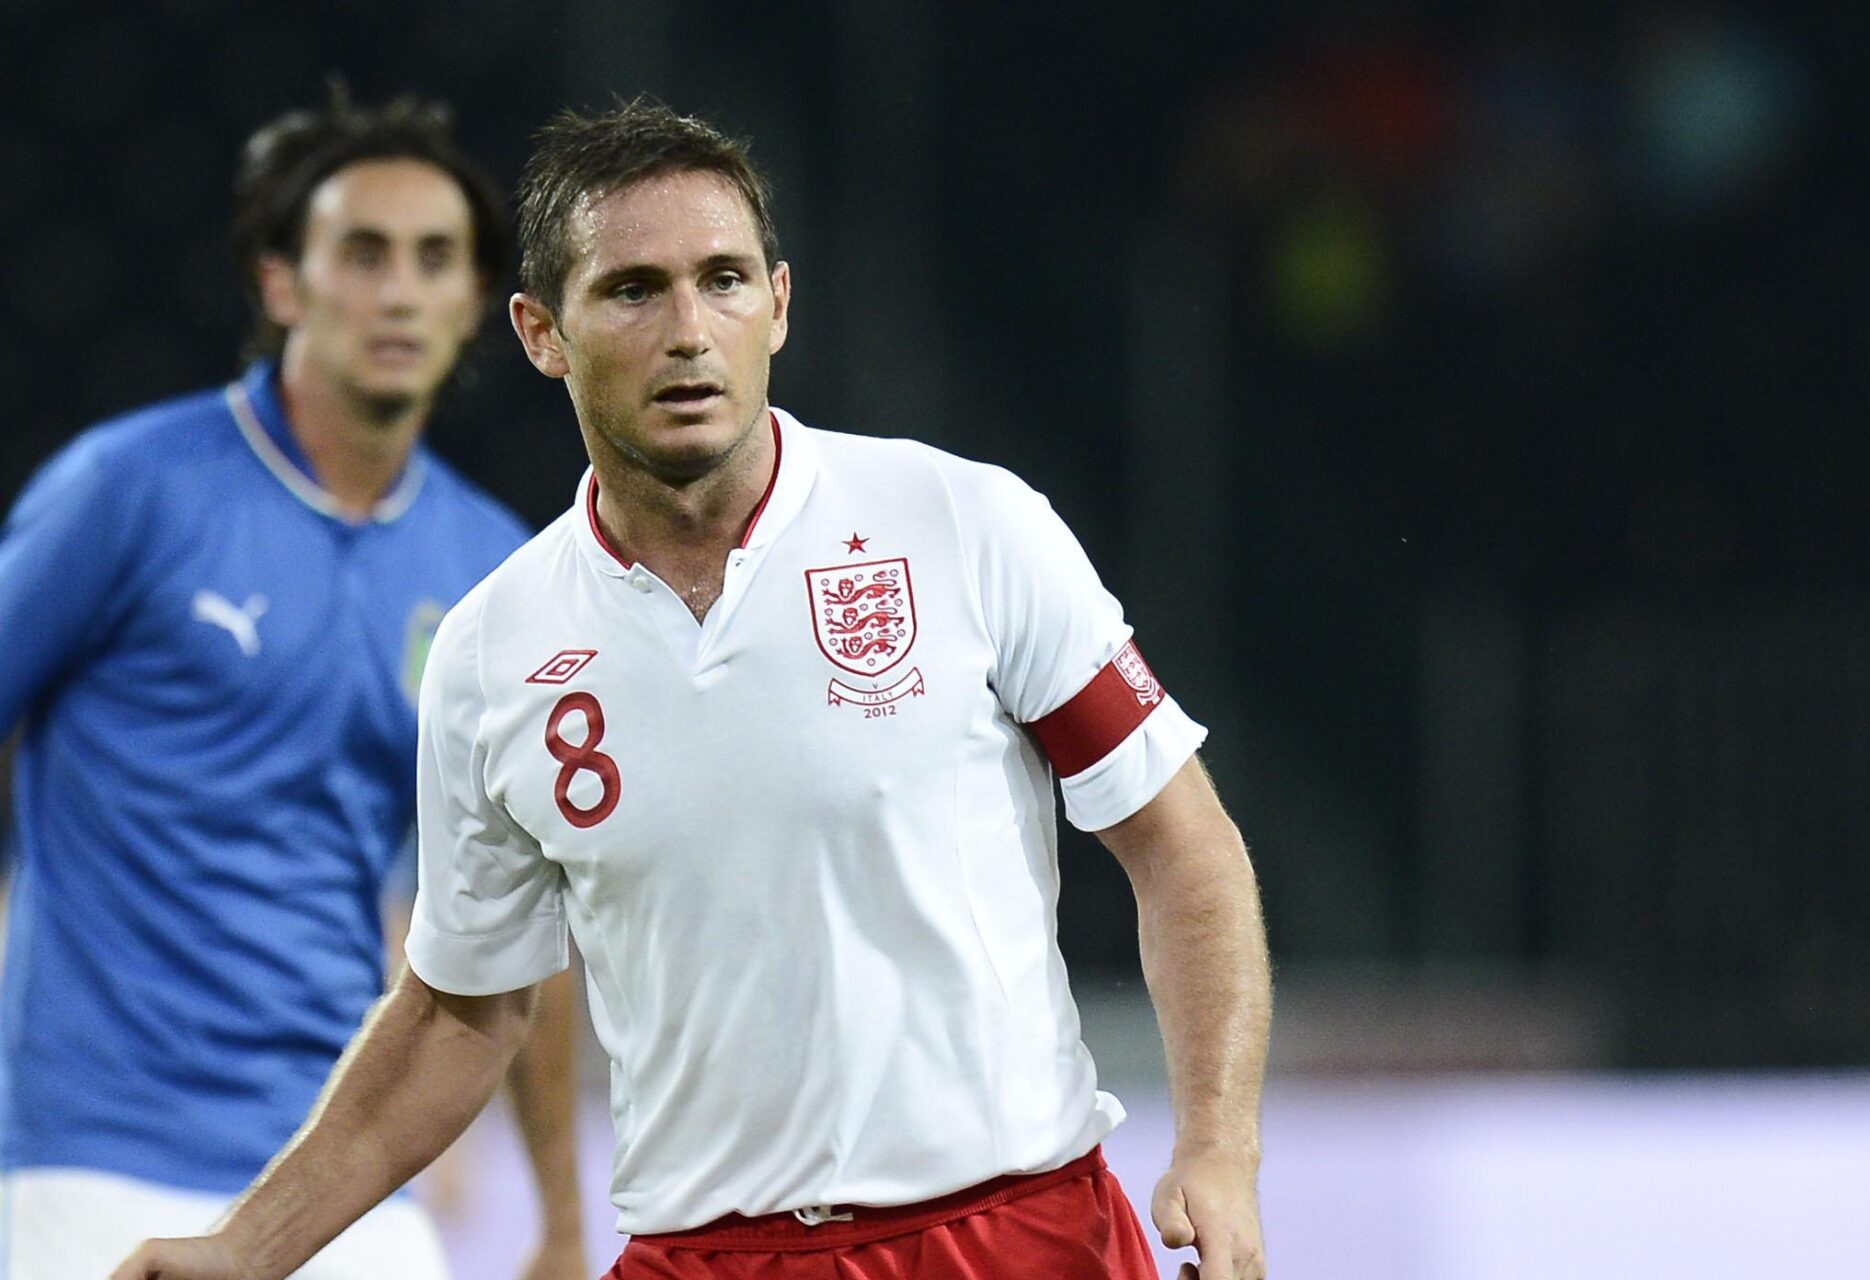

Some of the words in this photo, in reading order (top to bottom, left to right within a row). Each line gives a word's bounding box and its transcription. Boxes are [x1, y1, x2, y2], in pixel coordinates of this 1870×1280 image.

[863, 691, 894, 702] ITALY
[864, 705, 897, 719] 2012
[545, 691, 621, 829] 8
